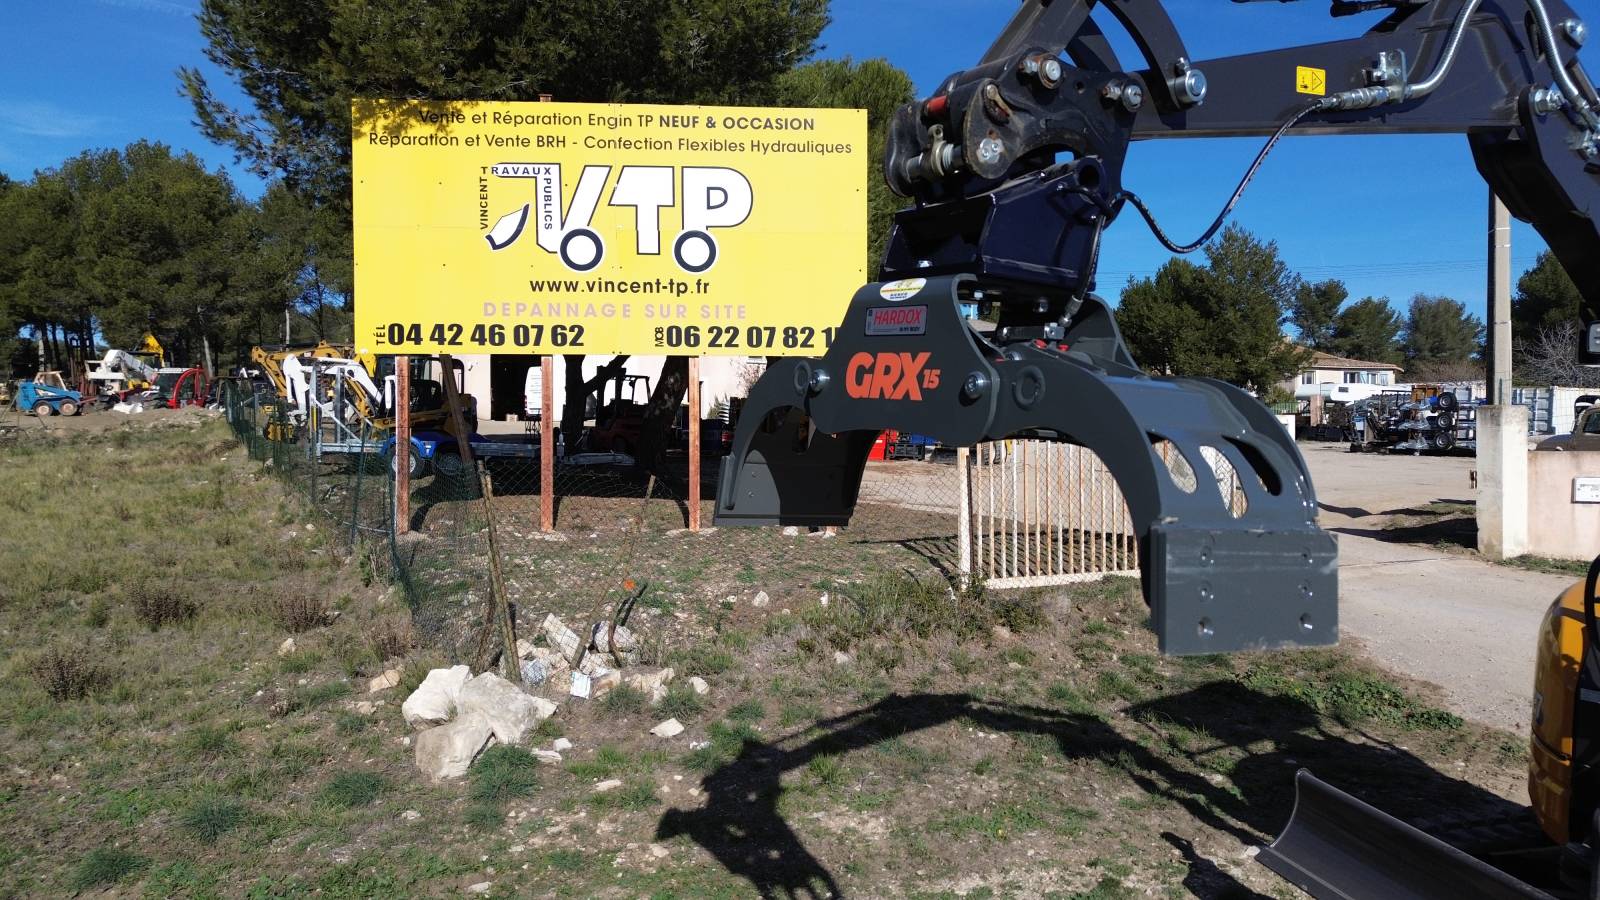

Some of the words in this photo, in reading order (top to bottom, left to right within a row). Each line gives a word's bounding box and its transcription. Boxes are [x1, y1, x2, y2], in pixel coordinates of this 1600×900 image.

[418, 110, 466, 125] Vente
[471, 112, 487, 125] et
[493, 111, 583, 128] Réparation
[588, 113, 633, 130] Engin
[637, 115, 654, 127] TP
[659, 115, 700, 128] NEUF
[705, 116, 717, 128] &
[723, 117, 815, 130] OCCASION
[368, 132, 459, 149] Réparation
[465, 134, 480, 147] et
[485, 134, 531, 148] Vente
[537, 135, 567, 148] BRH
[584, 136, 673, 150] Confection
[678, 138, 746, 152] Flexibles
[750, 139, 853, 155] Hydrauliques
[481, 166, 552, 176] TRAVAUX
[479, 176, 489, 231] VINCENT
[543, 177, 553, 231] PUBLICS
[529, 277, 710, 297] www.vincent-tp.fr
[482, 302, 632, 319] DEPANNAGE
[644, 304, 689, 319] SUR
[700, 304, 747, 320] SITE
[873, 309, 923, 326] HARDOX
[373, 323, 386, 346] TÉL
[387, 323, 424, 346] 04
[429, 323, 464, 346] 42
[470, 324, 506, 346] 46
[513, 324, 546, 347] 07
[550, 324, 585, 347] 62
[655, 327, 665, 347] MOB
[666, 325, 701, 348] 06
[707, 326, 740, 348] 22
[746, 326, 777, 348] 07
[782, 326, 815, 348] 82
[845, 351, 932, 401] GRX
[922, 369, 942, 390] 15
